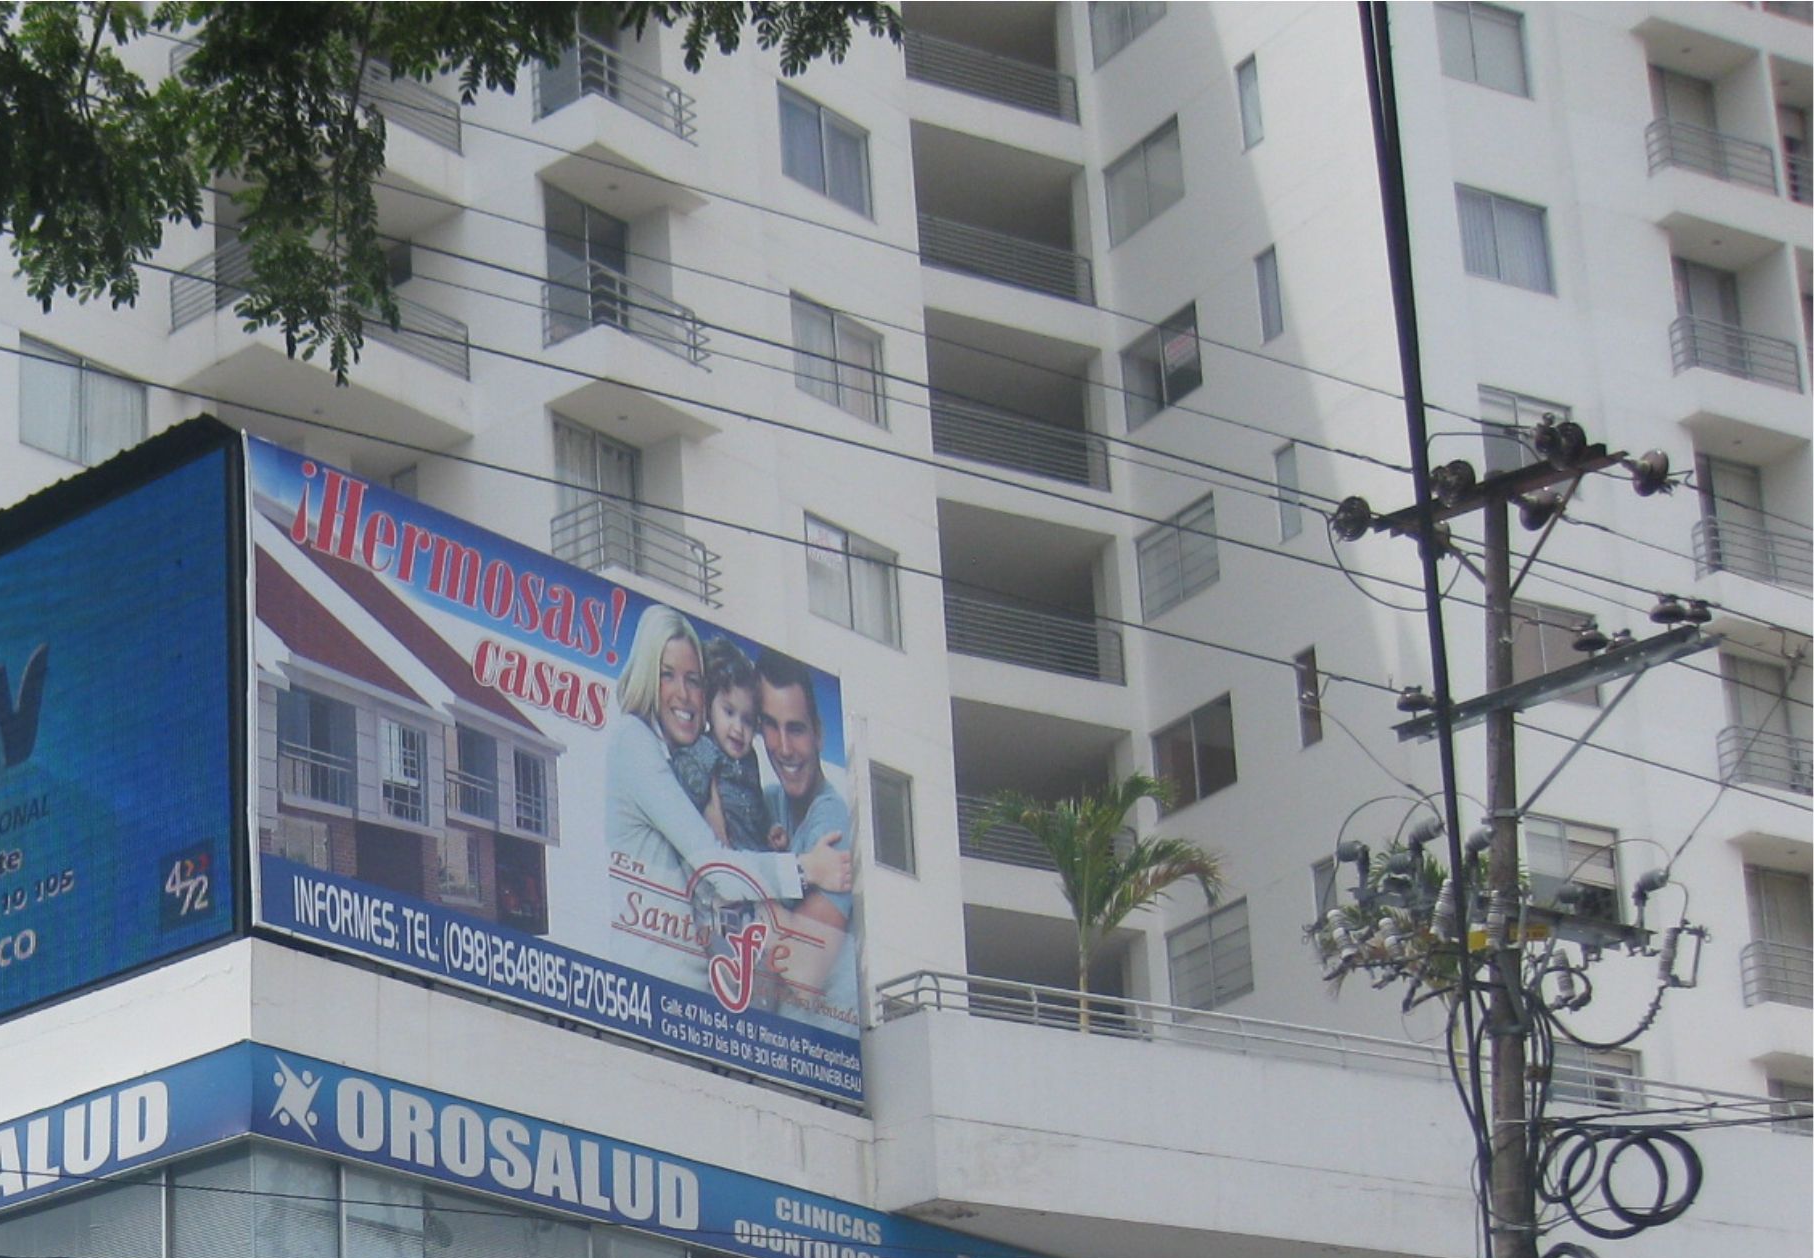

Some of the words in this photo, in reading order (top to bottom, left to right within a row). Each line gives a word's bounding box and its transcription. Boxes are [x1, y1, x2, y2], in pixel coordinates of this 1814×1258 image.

[290, 461, 627, 666] ¡Hermosas!
[473, 638, 610, 729] casas
[35, 868, 74, 901] 105
[611, 851, 645, 874] En
[293, 875, 400, 950] INFORMES:
[402, 907, 440, 963] TEL:
[619, 891, 713, 947] Santa
[661, 996, 683, 1017] Calle
[685, 1003, 697, 1021] 47
[700, 1008, 713, 1027] No
[714, 1014, 728, 1031] 64
[789, 1035, 801, 1051] de
[661, 1019, 679, 1039] Cra
[688, 1026, 700, 1046] No
[702, 1030, 714, 1048] 37
[715, 1033, 729, 1054] bis
[755, 1046, 770, 1066] 301
[791, 1058, 862, 1093] FONTAINEBLEAU
[337, 1078, 699, 1231] OROSALUD
[775, 1198, 881, 1245] CLINICAS
